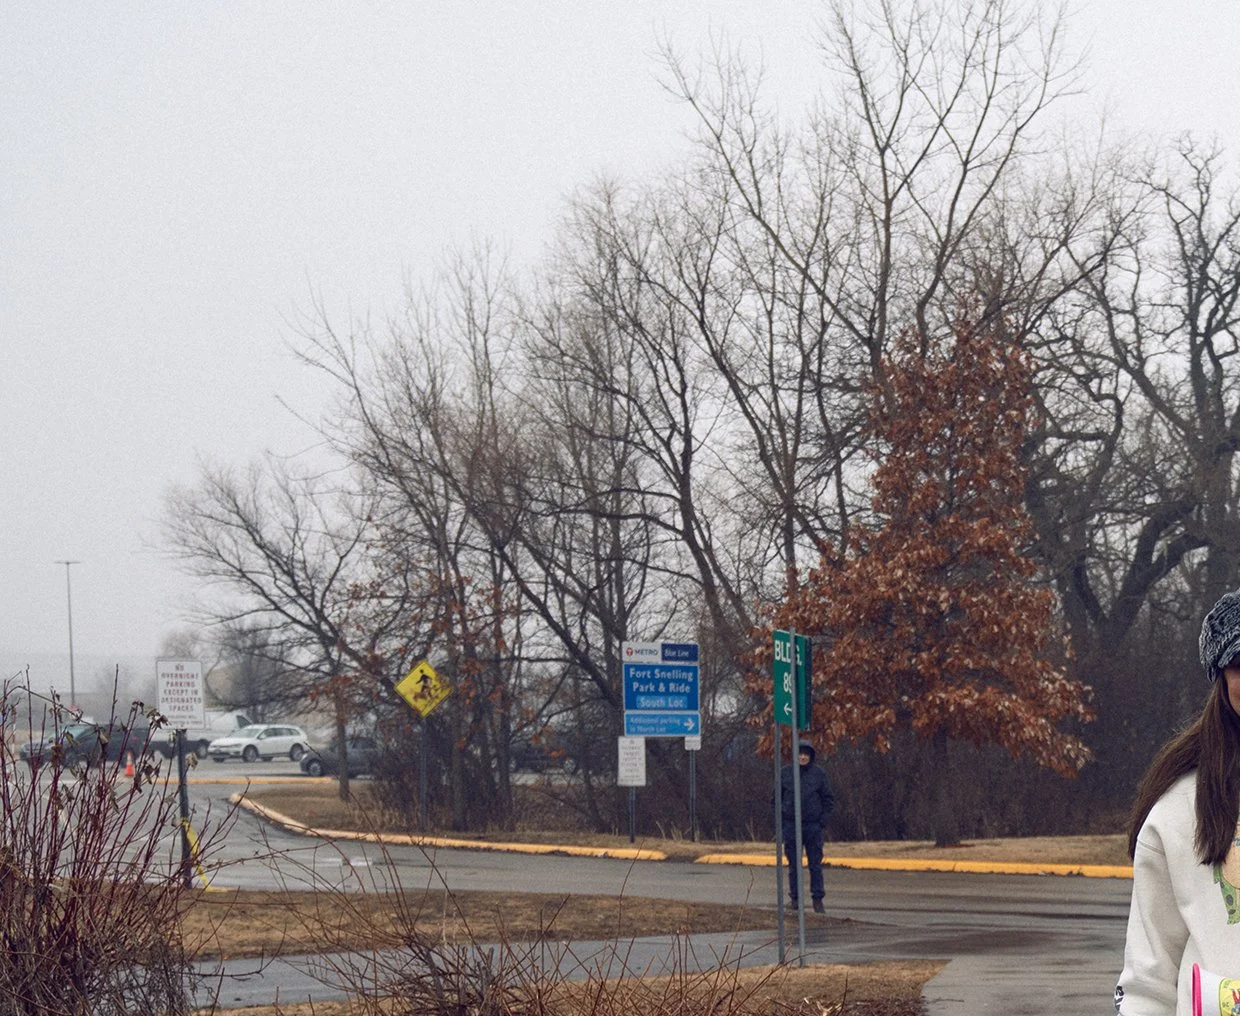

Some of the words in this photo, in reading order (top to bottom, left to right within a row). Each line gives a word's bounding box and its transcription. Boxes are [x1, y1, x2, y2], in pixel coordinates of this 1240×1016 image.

[629, 667, 651, 679] Fort
[654, 668, 693, 682] Snelling
[632, 682, 655, 692] Park
[658, 682, 666, 693] &
[669, 682, 691, 693] Ride
[640, 697, 666, 708] South
[668, 697, 684, 708] Lot
